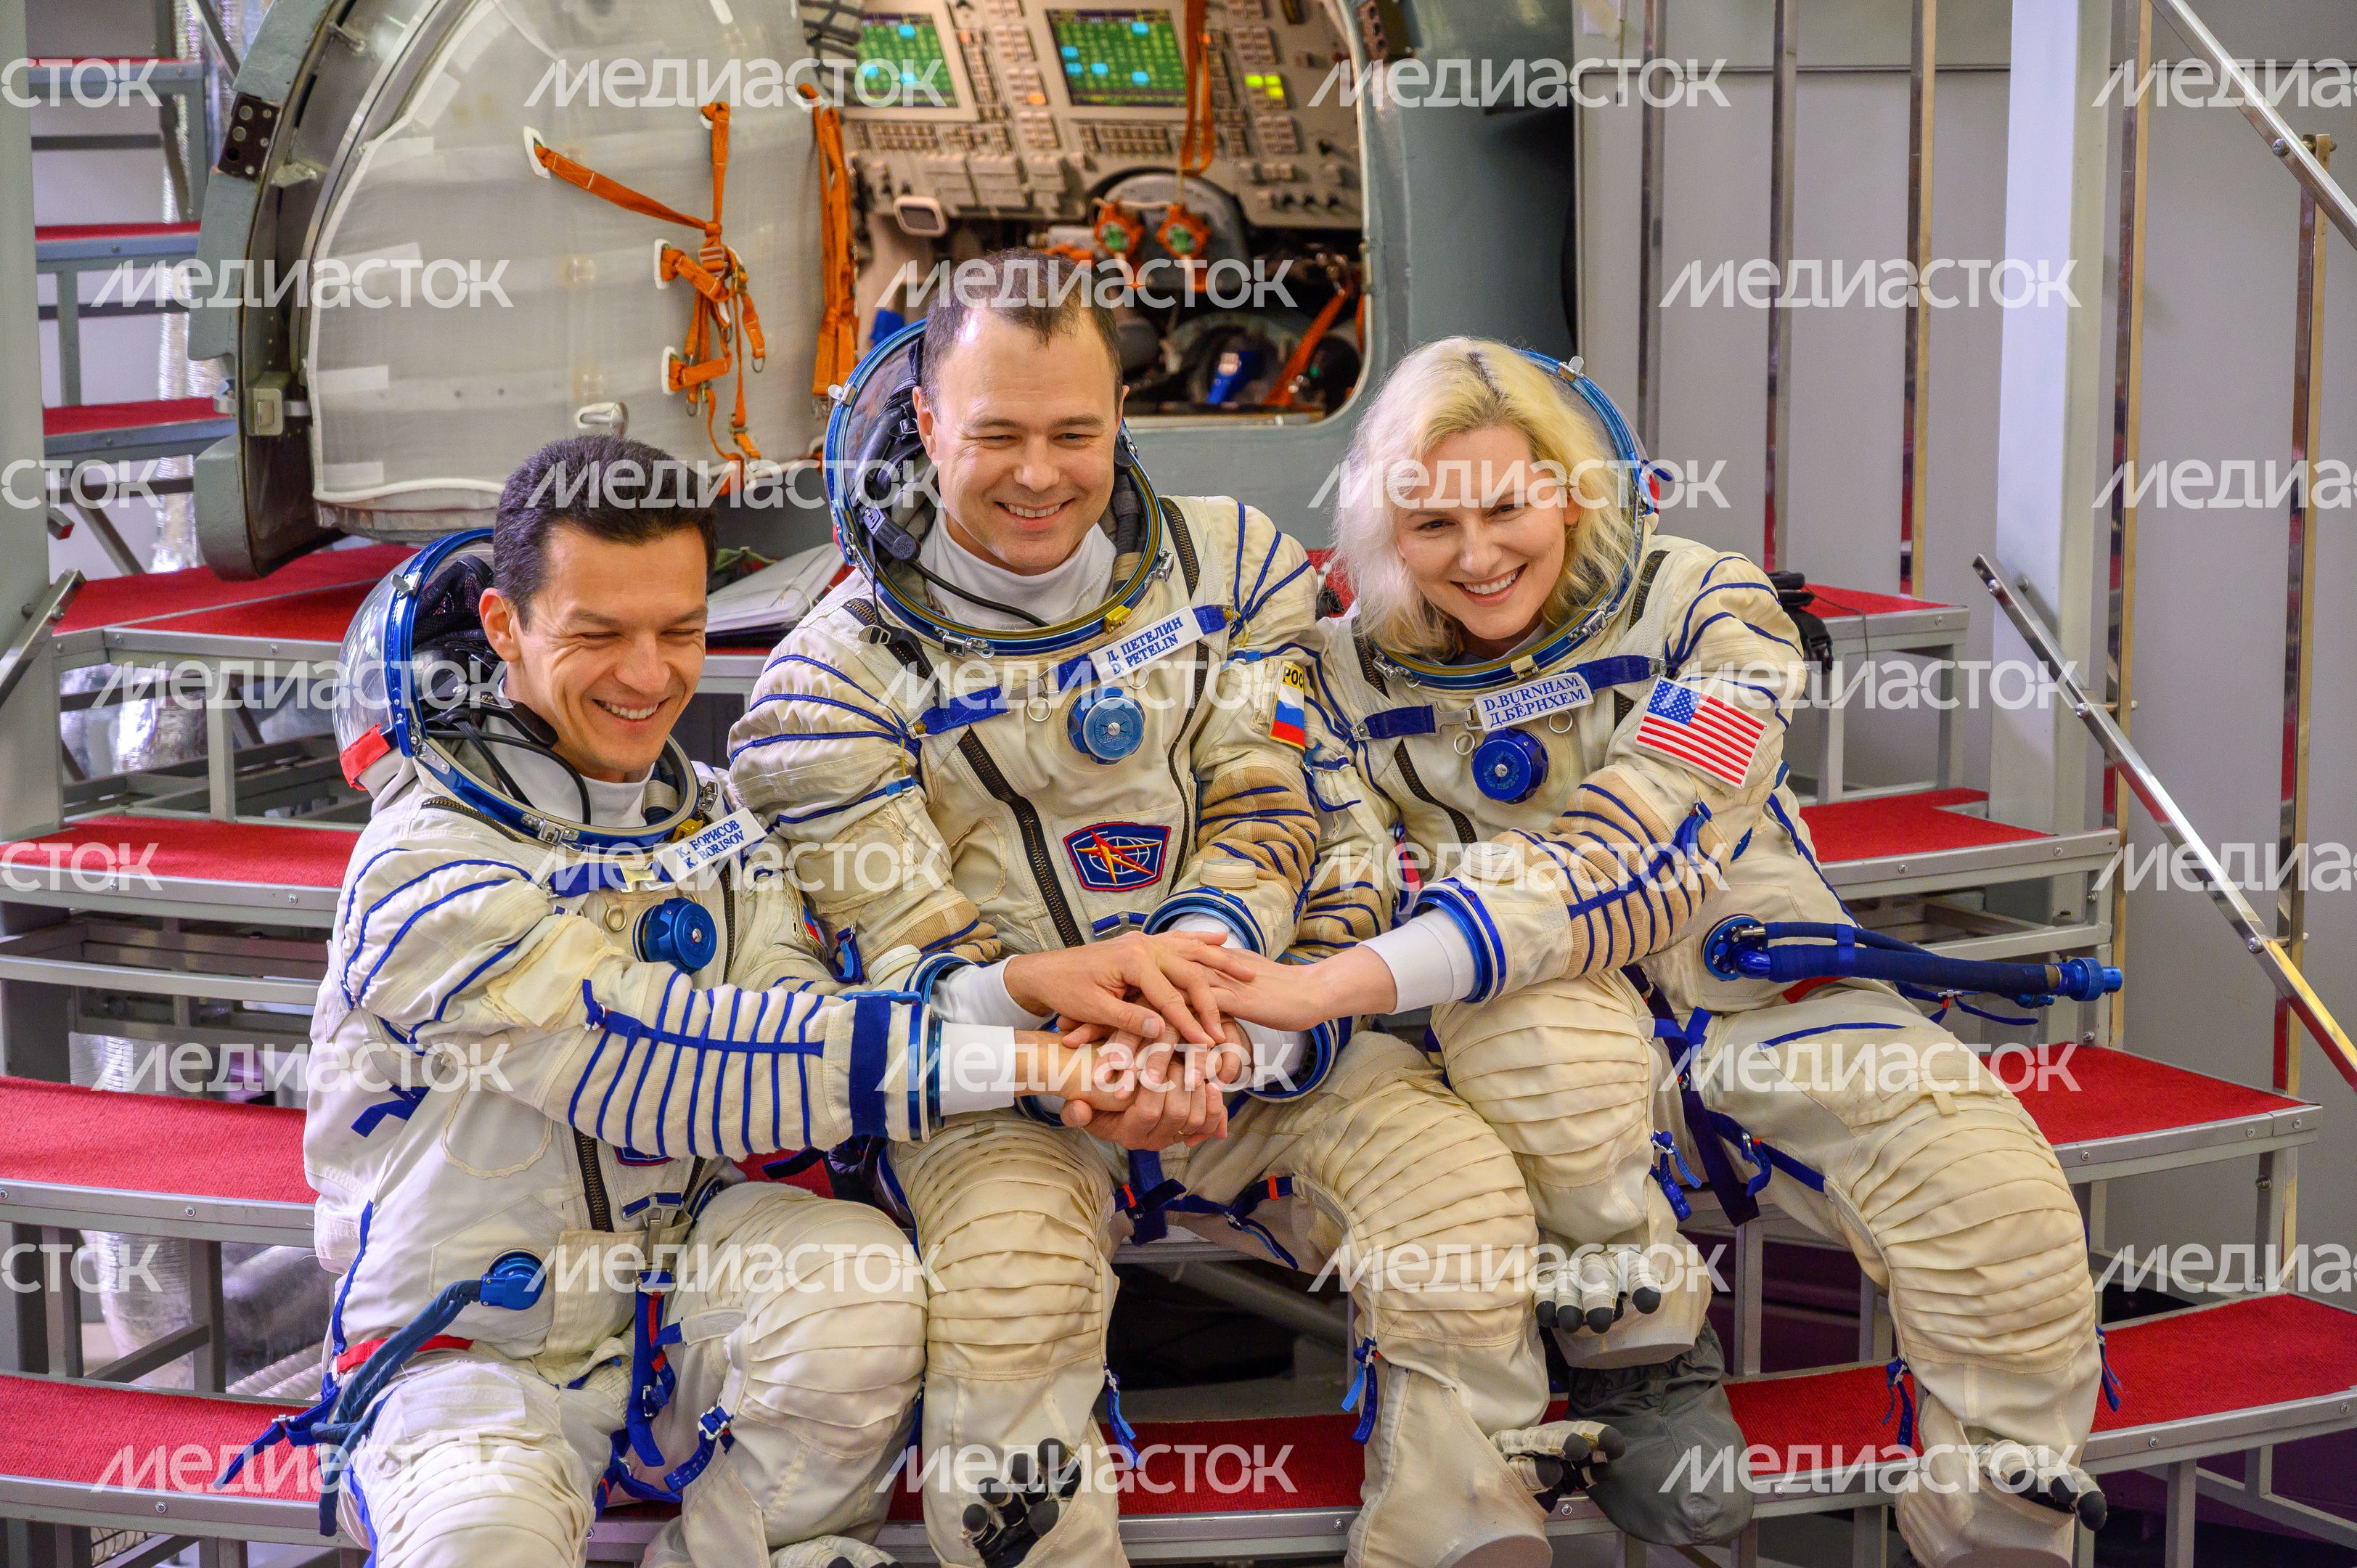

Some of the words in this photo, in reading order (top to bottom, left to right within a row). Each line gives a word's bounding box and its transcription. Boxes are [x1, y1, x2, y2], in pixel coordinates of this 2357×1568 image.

[1111, 662, 1124, 675] D.
[1124, 633, 1179, 668] PETELIN
[1120, 616, 1184, 656] ПЕТЕЛИН
[1483, 677, 1581, 712] D.BURNHAM
[1490, 688, 1587, 727] Д.БЁРНХЕМ
[689, 820, 740, 852] БОРИСОВ
[697, 830, 745, 860] BORISOV
